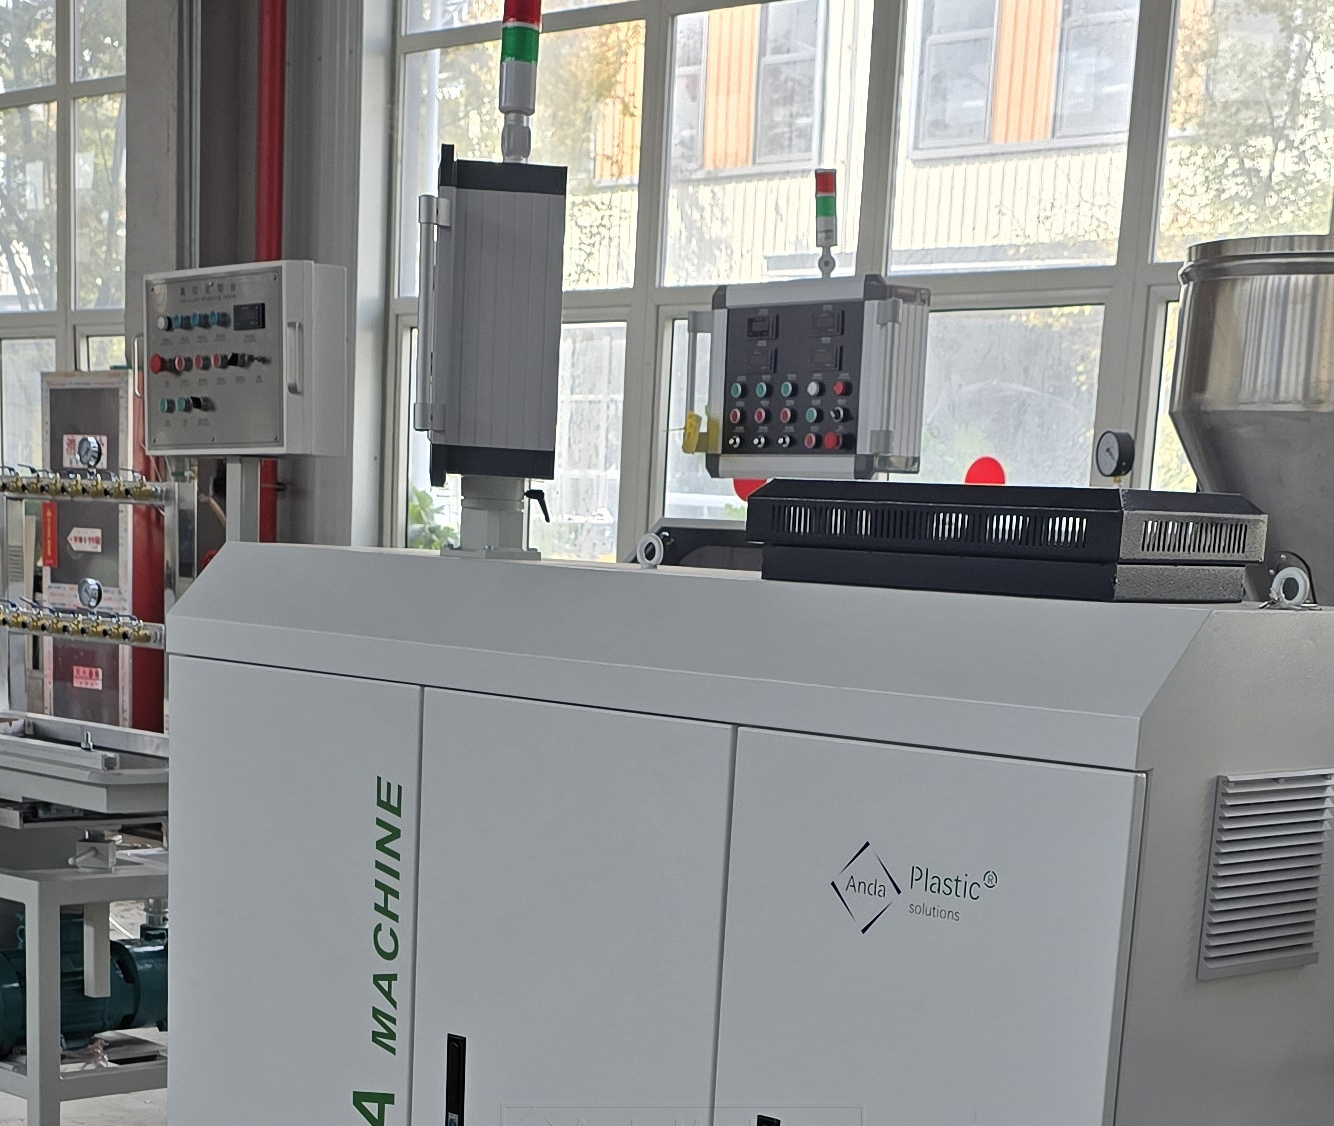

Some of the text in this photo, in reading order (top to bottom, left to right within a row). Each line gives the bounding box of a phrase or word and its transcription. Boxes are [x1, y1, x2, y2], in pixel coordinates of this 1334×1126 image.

[845, 874, 886, 898] Anda
[371, 775, 403, 1056] MACHINE
[908, 902, 961, 922] solutions
